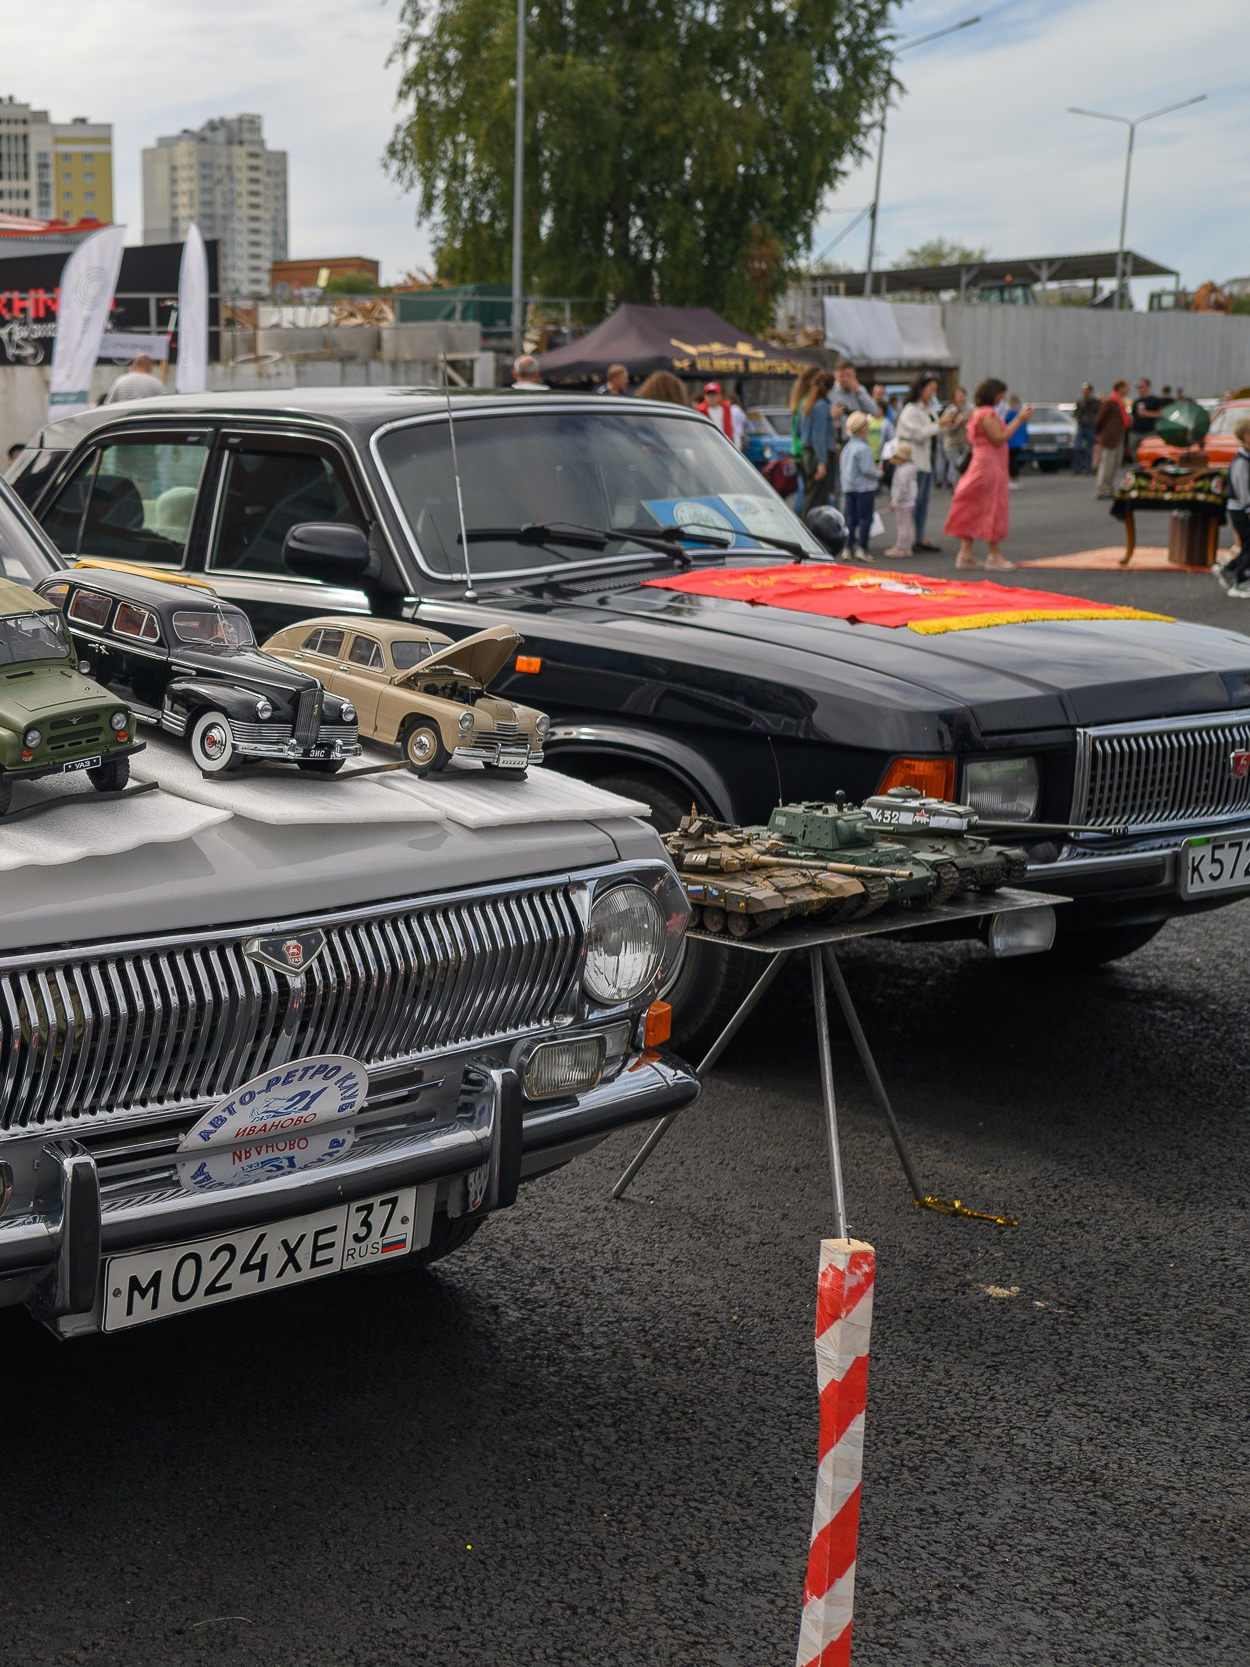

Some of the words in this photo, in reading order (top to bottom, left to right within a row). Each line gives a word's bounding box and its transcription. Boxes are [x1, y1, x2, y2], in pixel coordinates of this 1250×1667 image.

[309, 749, 326, 758] ЗИС
[75, 760, 91, 770] УАЗ
[875, 809, 900, 824] 432
[234, 1112, 318, 1139] ИВАНОВО
[125, 1224, 339, 1318] М024ХЕ
[351, 1195, 400, 1245] 37
[345, 1242, 380, 1262] RUS
